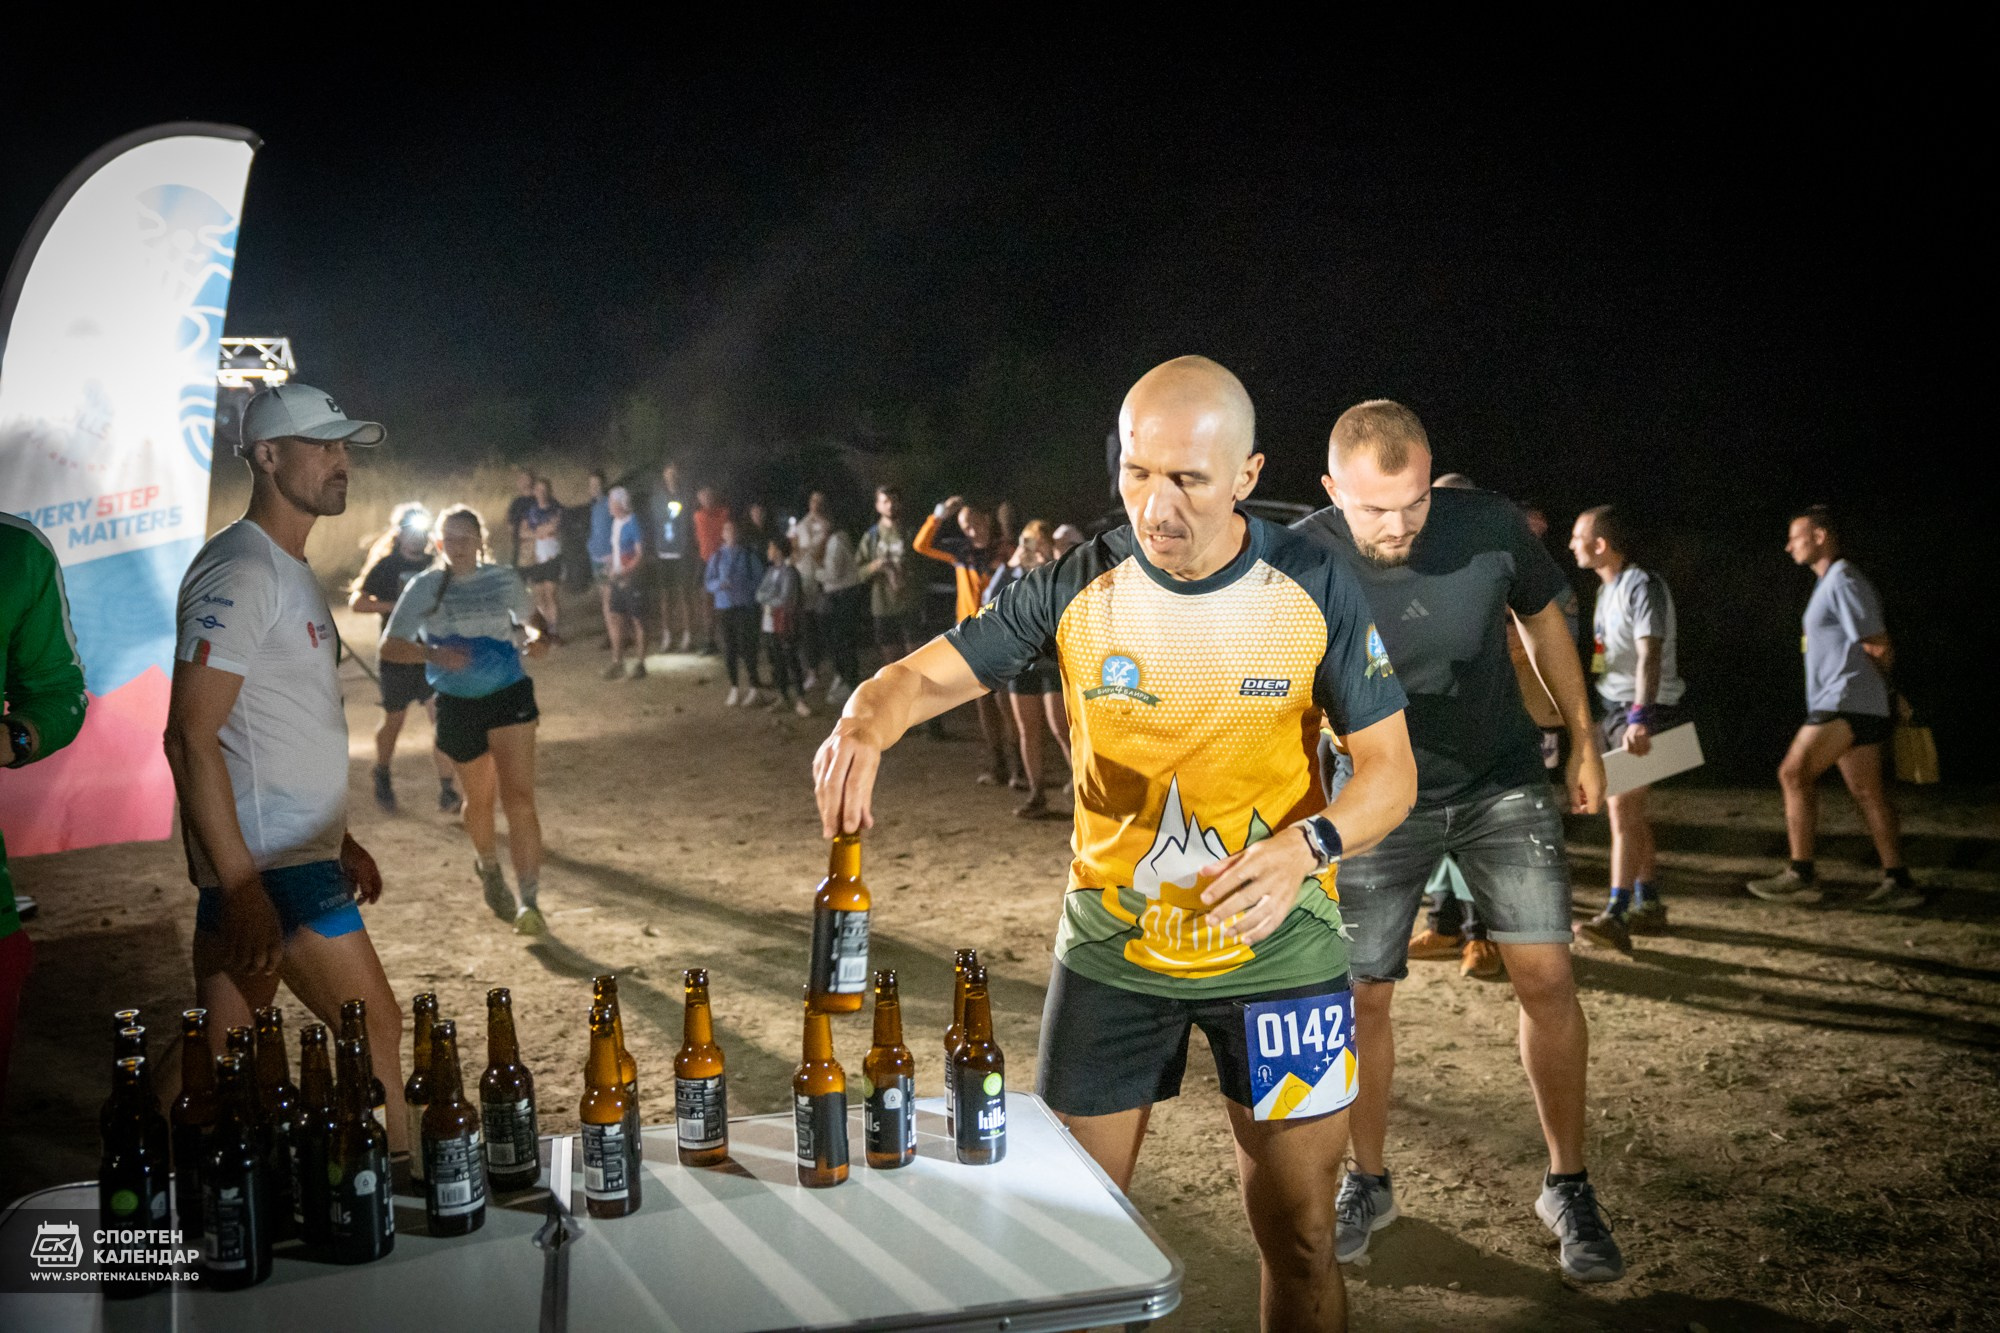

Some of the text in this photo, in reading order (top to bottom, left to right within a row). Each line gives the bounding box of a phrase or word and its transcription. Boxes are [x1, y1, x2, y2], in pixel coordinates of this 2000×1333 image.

[18, 485, 160, 529] VERY STEP
[68, 505, 183, 549] MATTERS
[1243, 679, 1288, 689] DIEM
[1257, 1004, 1345, 1058] 0142
[978, 1106, 1005, 1130] hills
